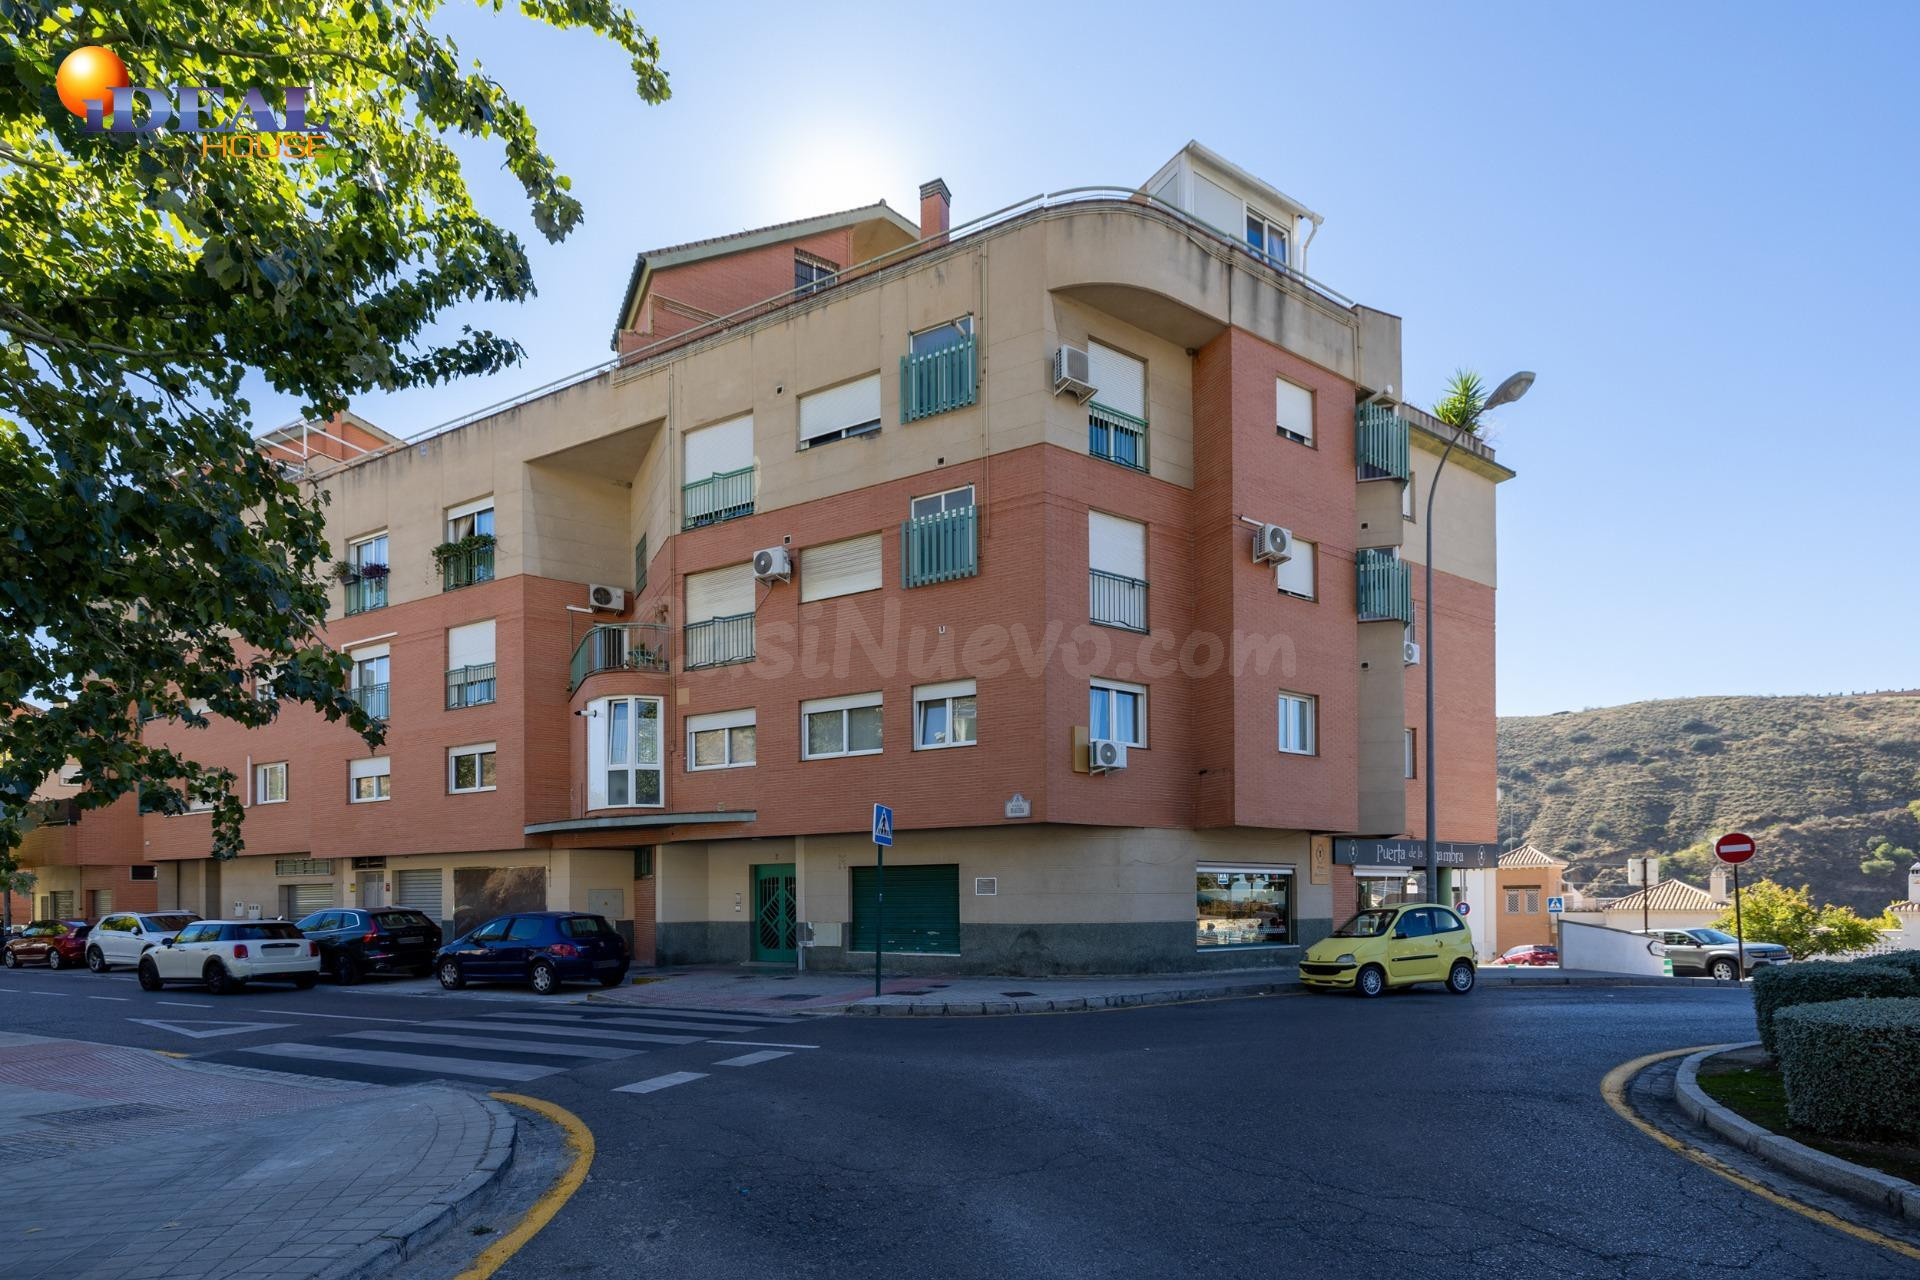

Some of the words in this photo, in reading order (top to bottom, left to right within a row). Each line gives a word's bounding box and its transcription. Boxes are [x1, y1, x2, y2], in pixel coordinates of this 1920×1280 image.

[1376, 843, 1406, 863] Puerta
[1408, 845, 1417, 858] de
[1426, 844, 1464, 863] ambra
